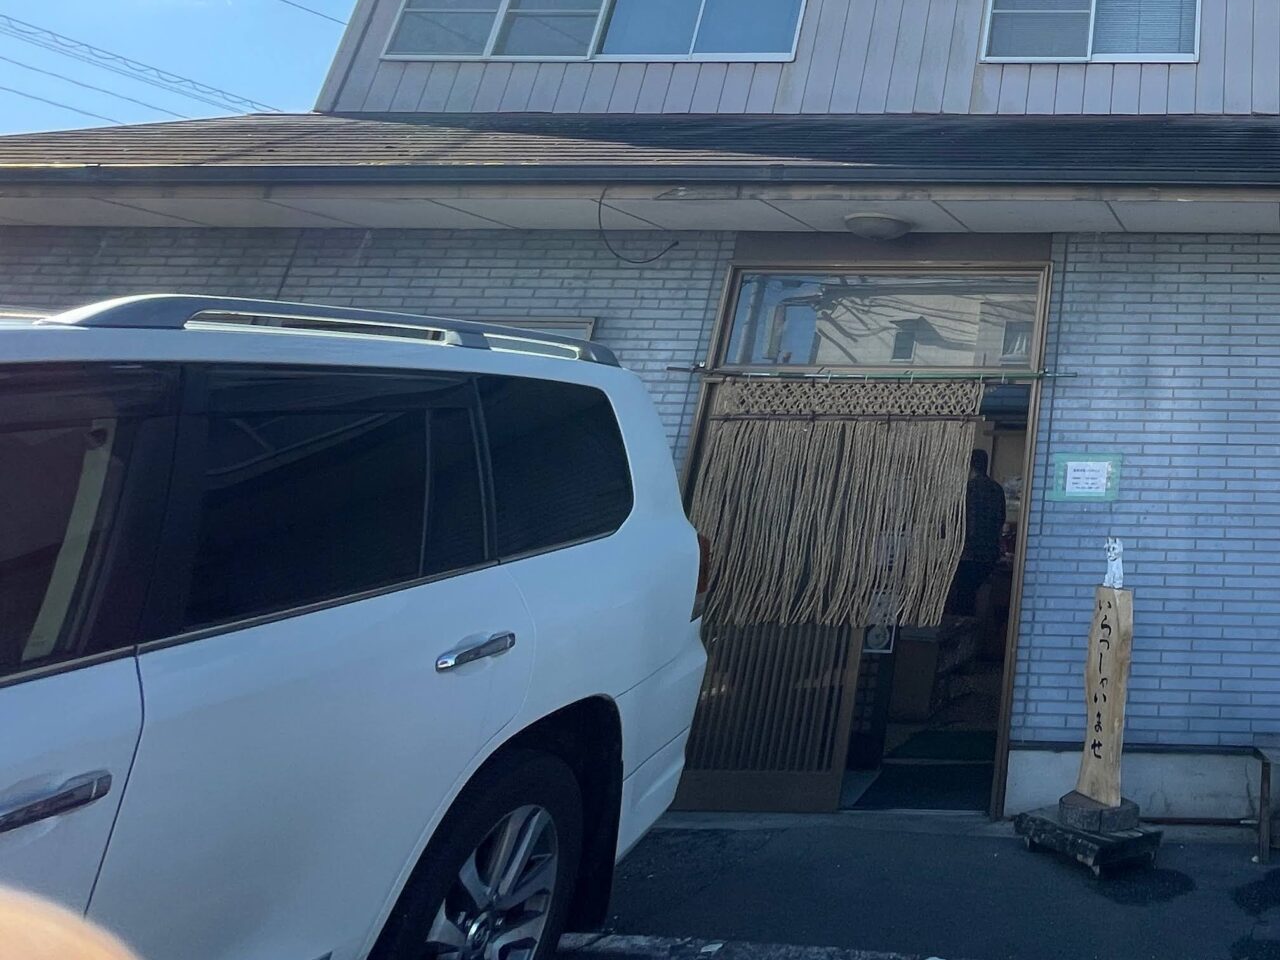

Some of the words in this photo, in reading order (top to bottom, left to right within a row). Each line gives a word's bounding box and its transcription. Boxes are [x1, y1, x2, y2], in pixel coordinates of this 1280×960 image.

[1091, 599, 1112, 759] いらっしゃいませ
